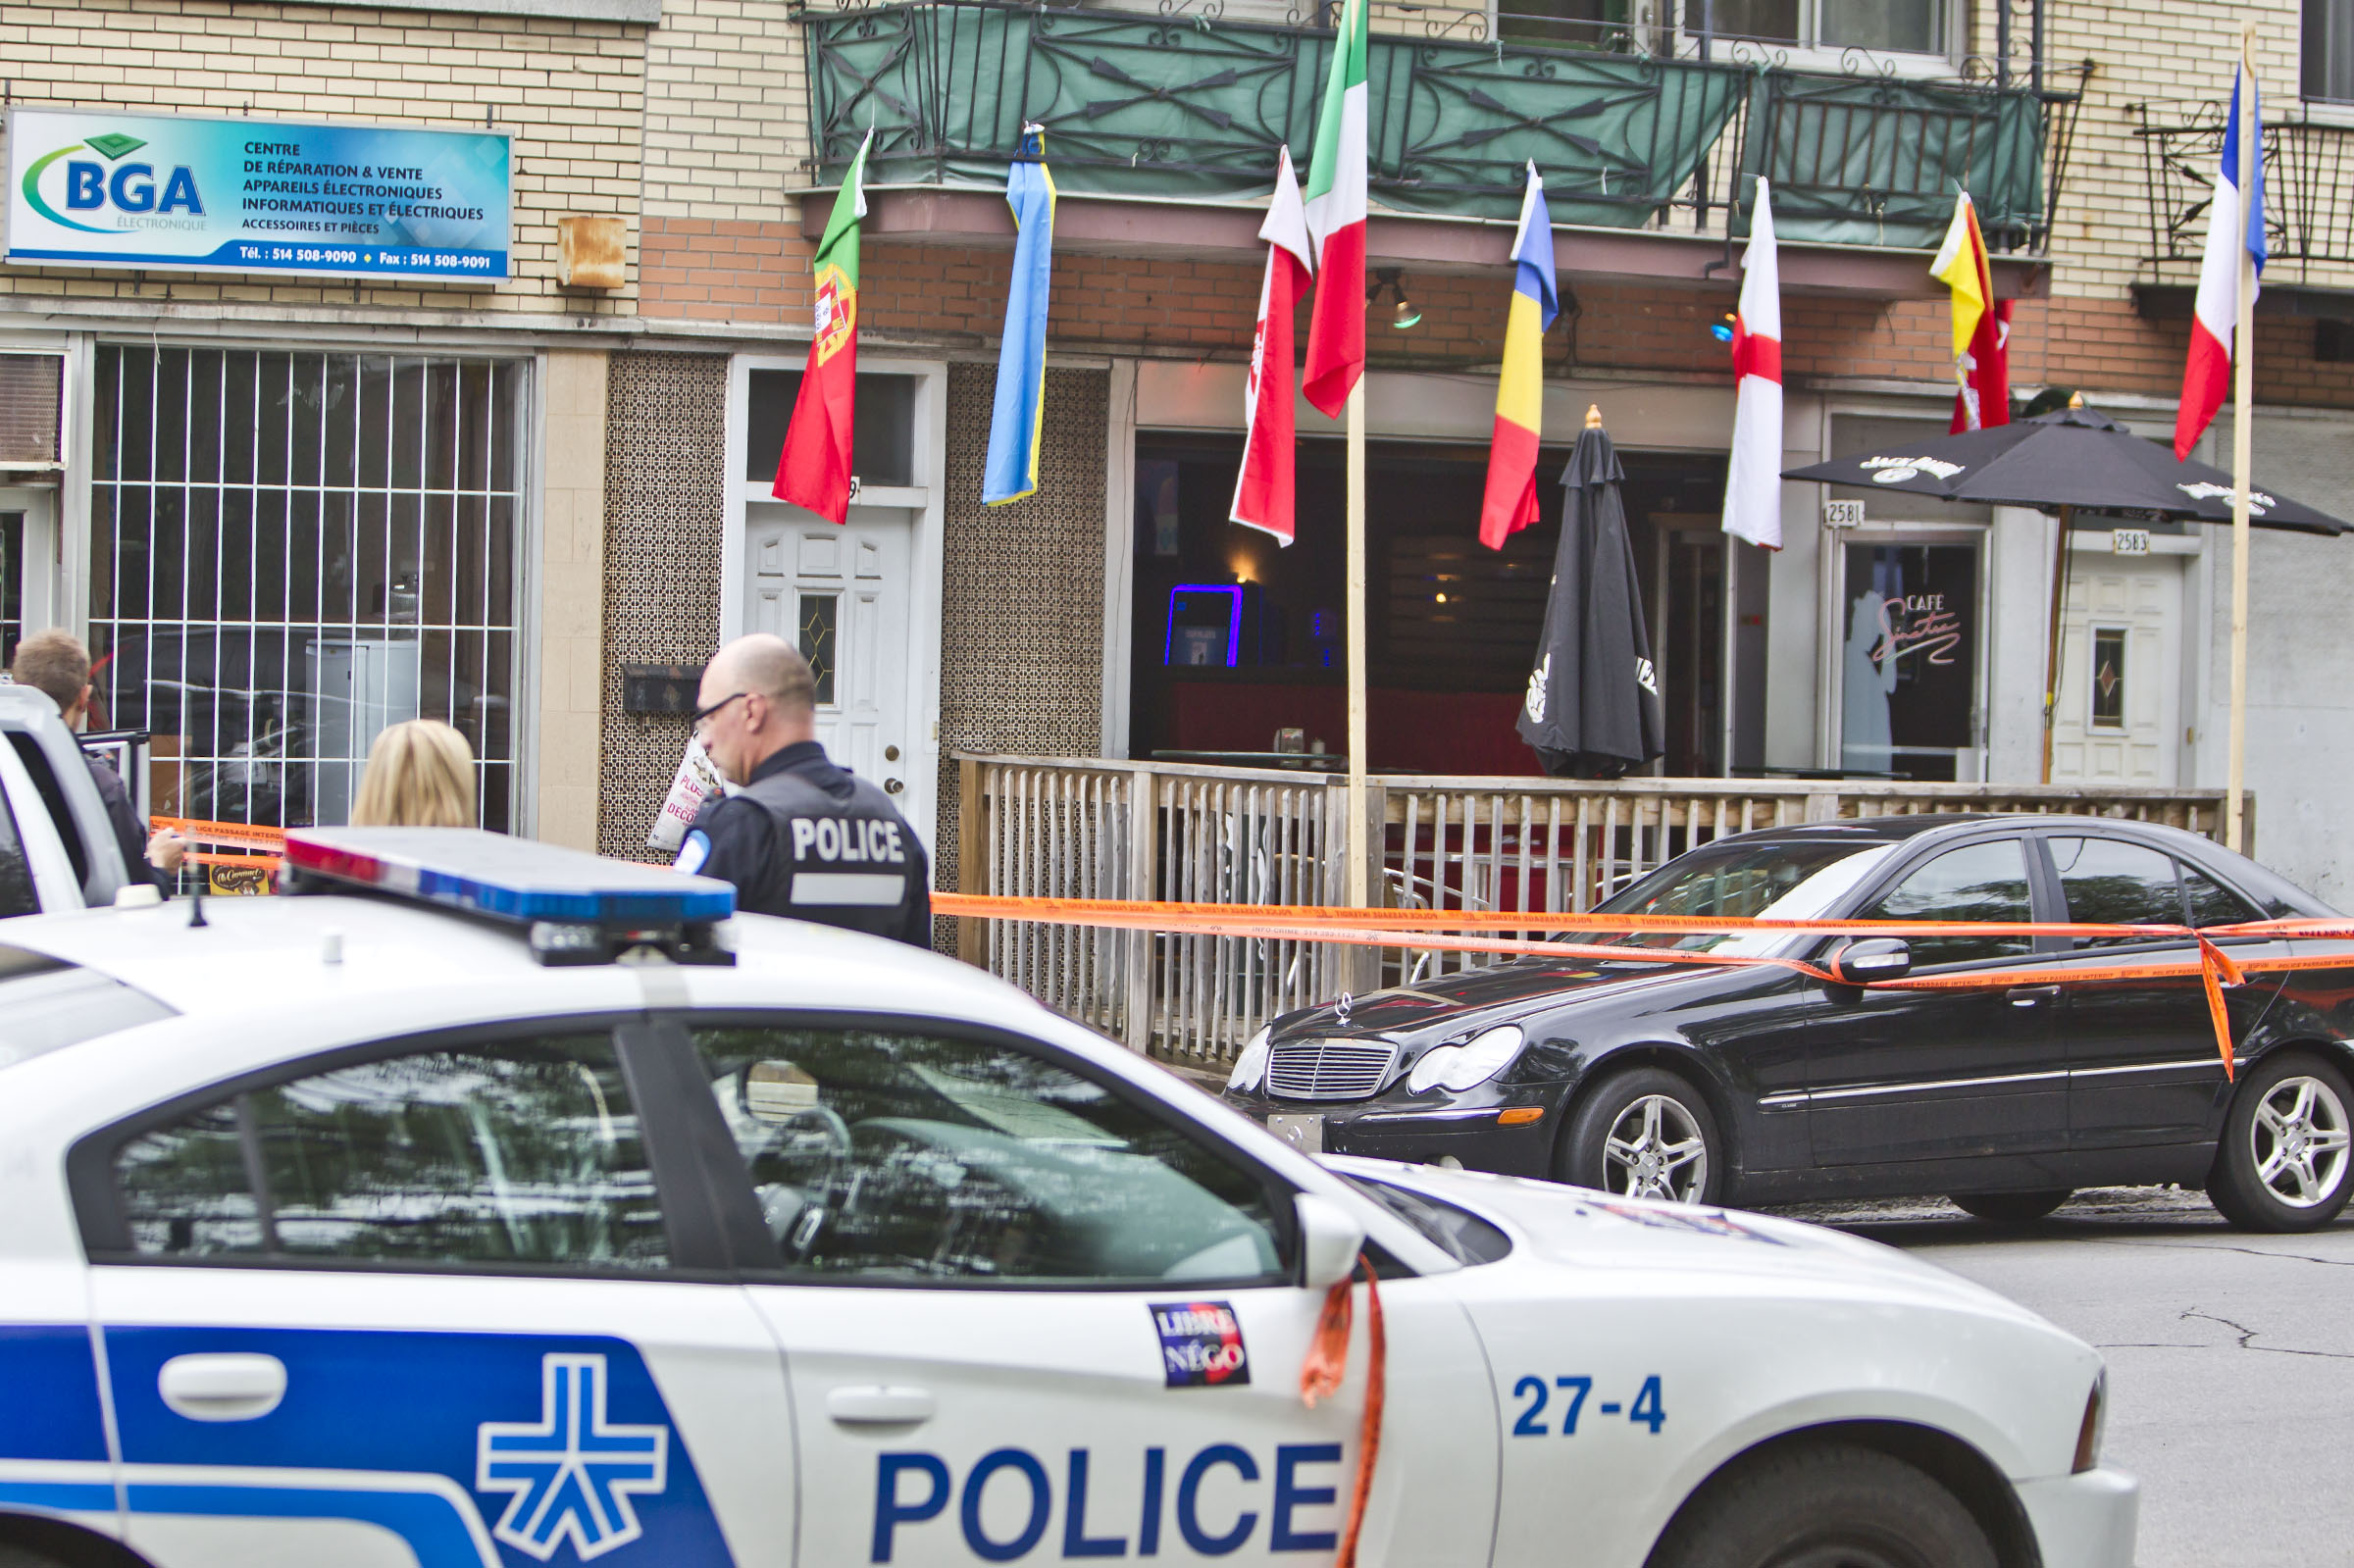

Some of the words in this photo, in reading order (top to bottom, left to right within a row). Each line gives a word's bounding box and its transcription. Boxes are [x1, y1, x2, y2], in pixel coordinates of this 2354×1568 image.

[244, 141, 300, 156] CENTRE
[243, 161, 263, 173] DE
[267, 159, 358, 177] RÉPARATION
[362, 165, 374, 178] &
[378, 167, 423, 179] VENTE
[66, 160, 206, 216] BGA
[243, 179, 319, 194] APPAREILS
[323, 179, 442, 199] ÉLECTRONIQUES
[242, 198, 364, 215] INFORMATIQUES
[369, 203, 384, 216] ET
[388, 201, 484, 221] ÉLECTRIQUES
[117, 215, 207, 231] ÉLECTRONIQUE
[242, 218, 321, 231] ACCESSOIRES
[325, 222, 337, 232] ET
[340, 221, 380, 234] PIÈCES
[239, 246, 261, 259] Tél.
[272, 247, 292, 261] 514
[296, 248, 356, 264] 508-9090
[380, 251, 399, 265] Fax
[411, 253, 431, 267] 514
[435, 254, 490, 269] 508-9091
[1829, 504, 1860, 522] 2581
[2118, 532, 2147, 551] 2583
[215, 828, 250, 836] PASSAGE
[791, 817, 905, 863] POLICE
[1157, 1308, 1237, 1337] LIBRE
[1165, 1339, 1245, 1373] NÉGO
[1512, 1375, 1666, 1436] 27-4
[871, 1442, 1343, 1564] POLICE
